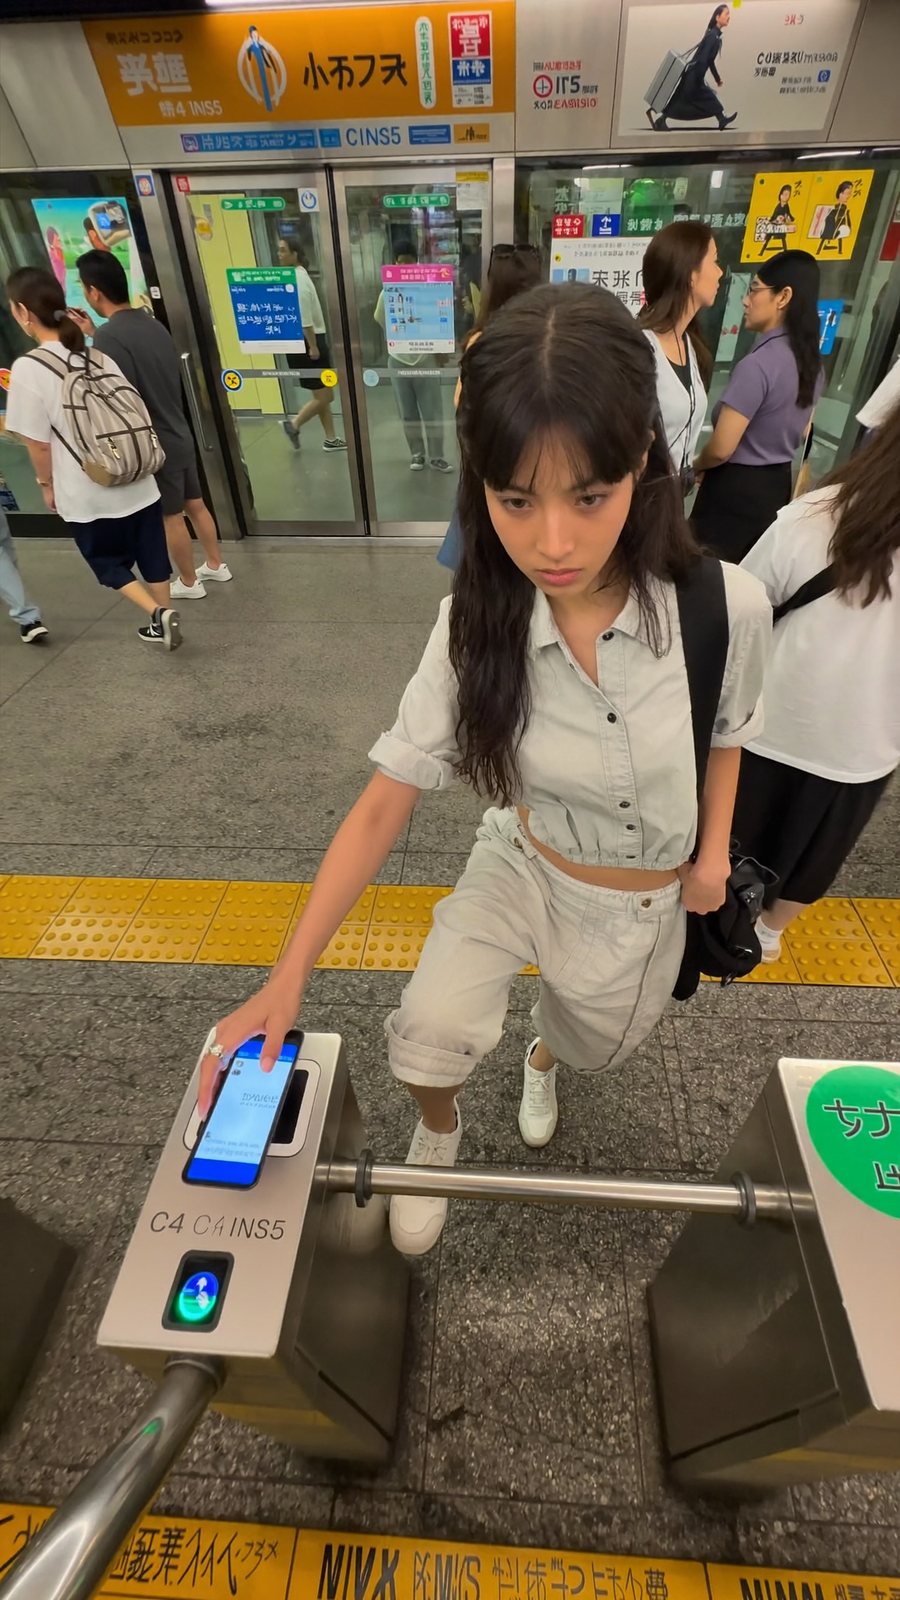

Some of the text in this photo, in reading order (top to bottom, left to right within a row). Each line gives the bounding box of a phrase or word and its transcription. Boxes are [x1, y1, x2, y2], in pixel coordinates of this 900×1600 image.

[345, 126, 402, 147] CINS5
[150, 1211, 185, 1234] C4
[229, 1217, 287, 1240] INS5
